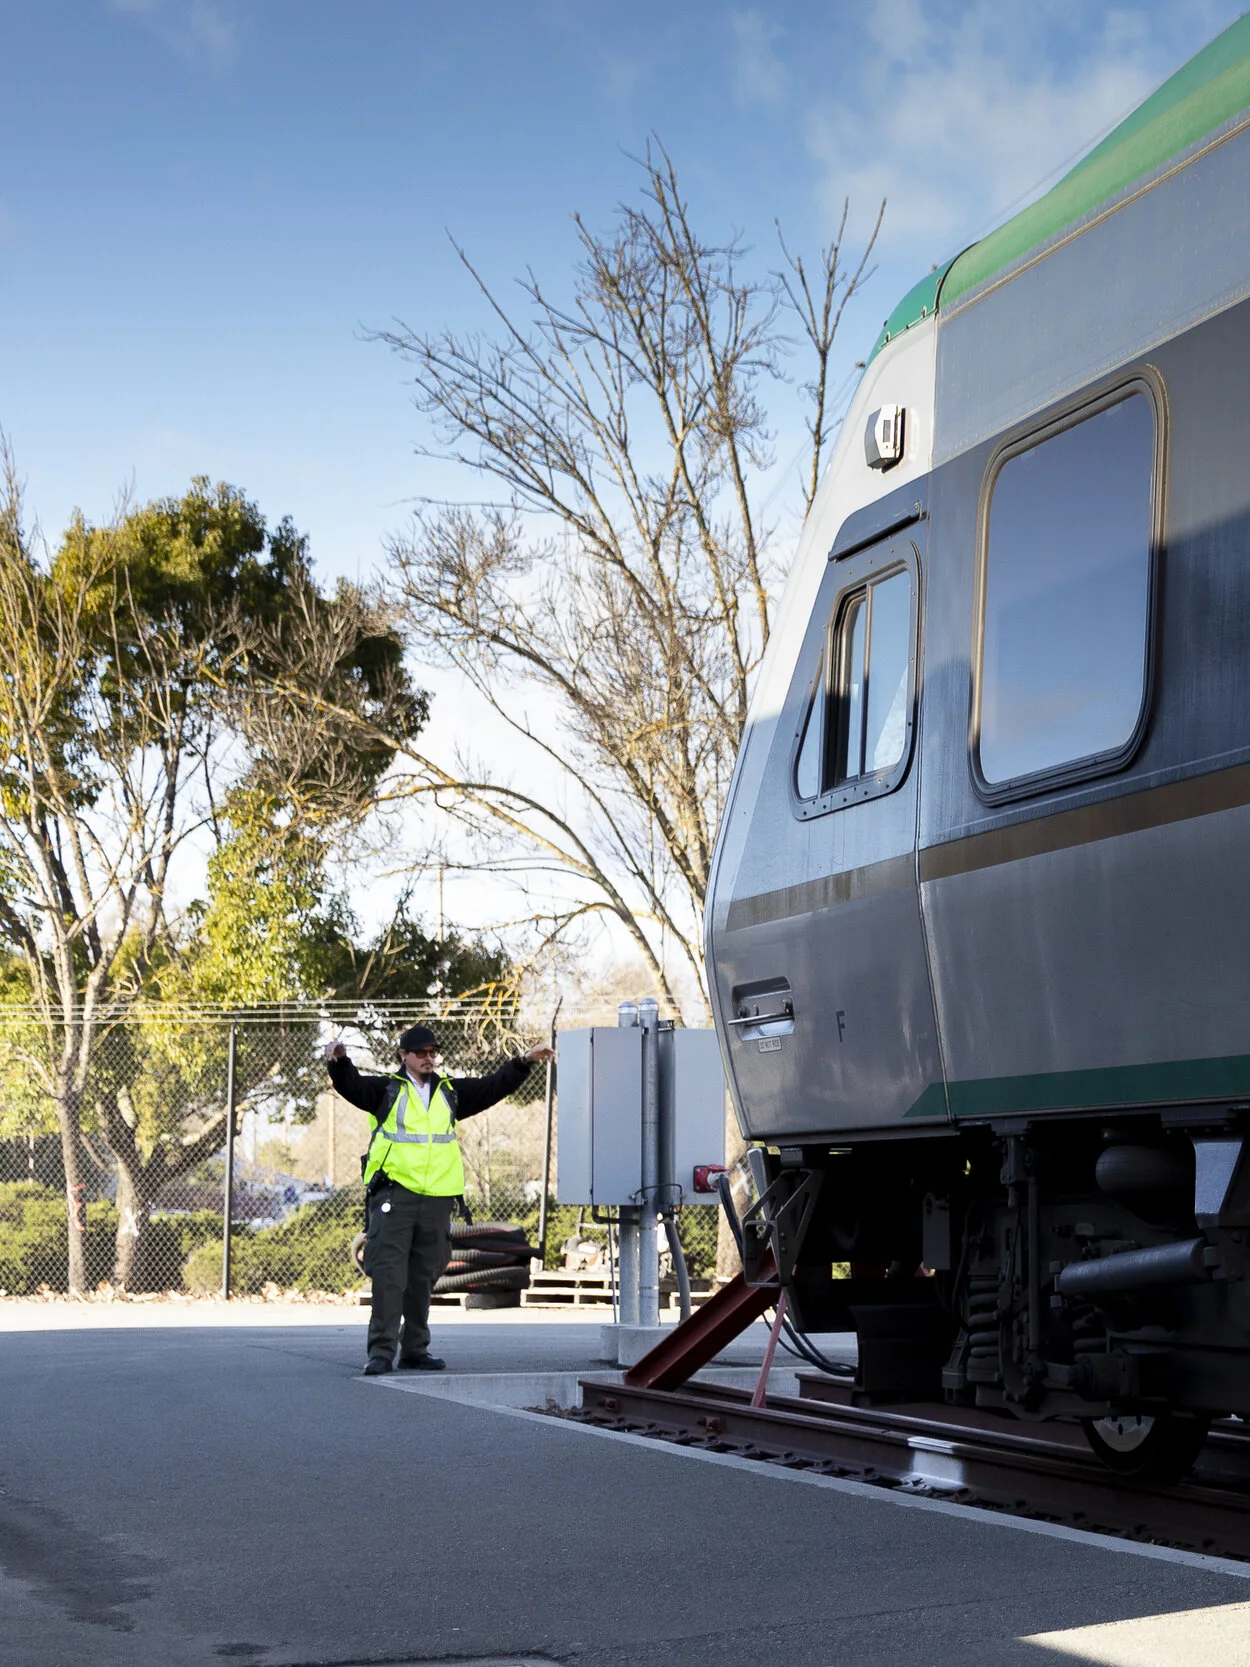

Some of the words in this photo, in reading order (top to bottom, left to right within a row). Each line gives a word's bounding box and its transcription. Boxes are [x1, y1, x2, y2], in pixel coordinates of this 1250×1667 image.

[836, 1010, 845, 1042] F
[760, 1041, 765, 1050] DO
[772, 1039, 780, 1048] RIDE
